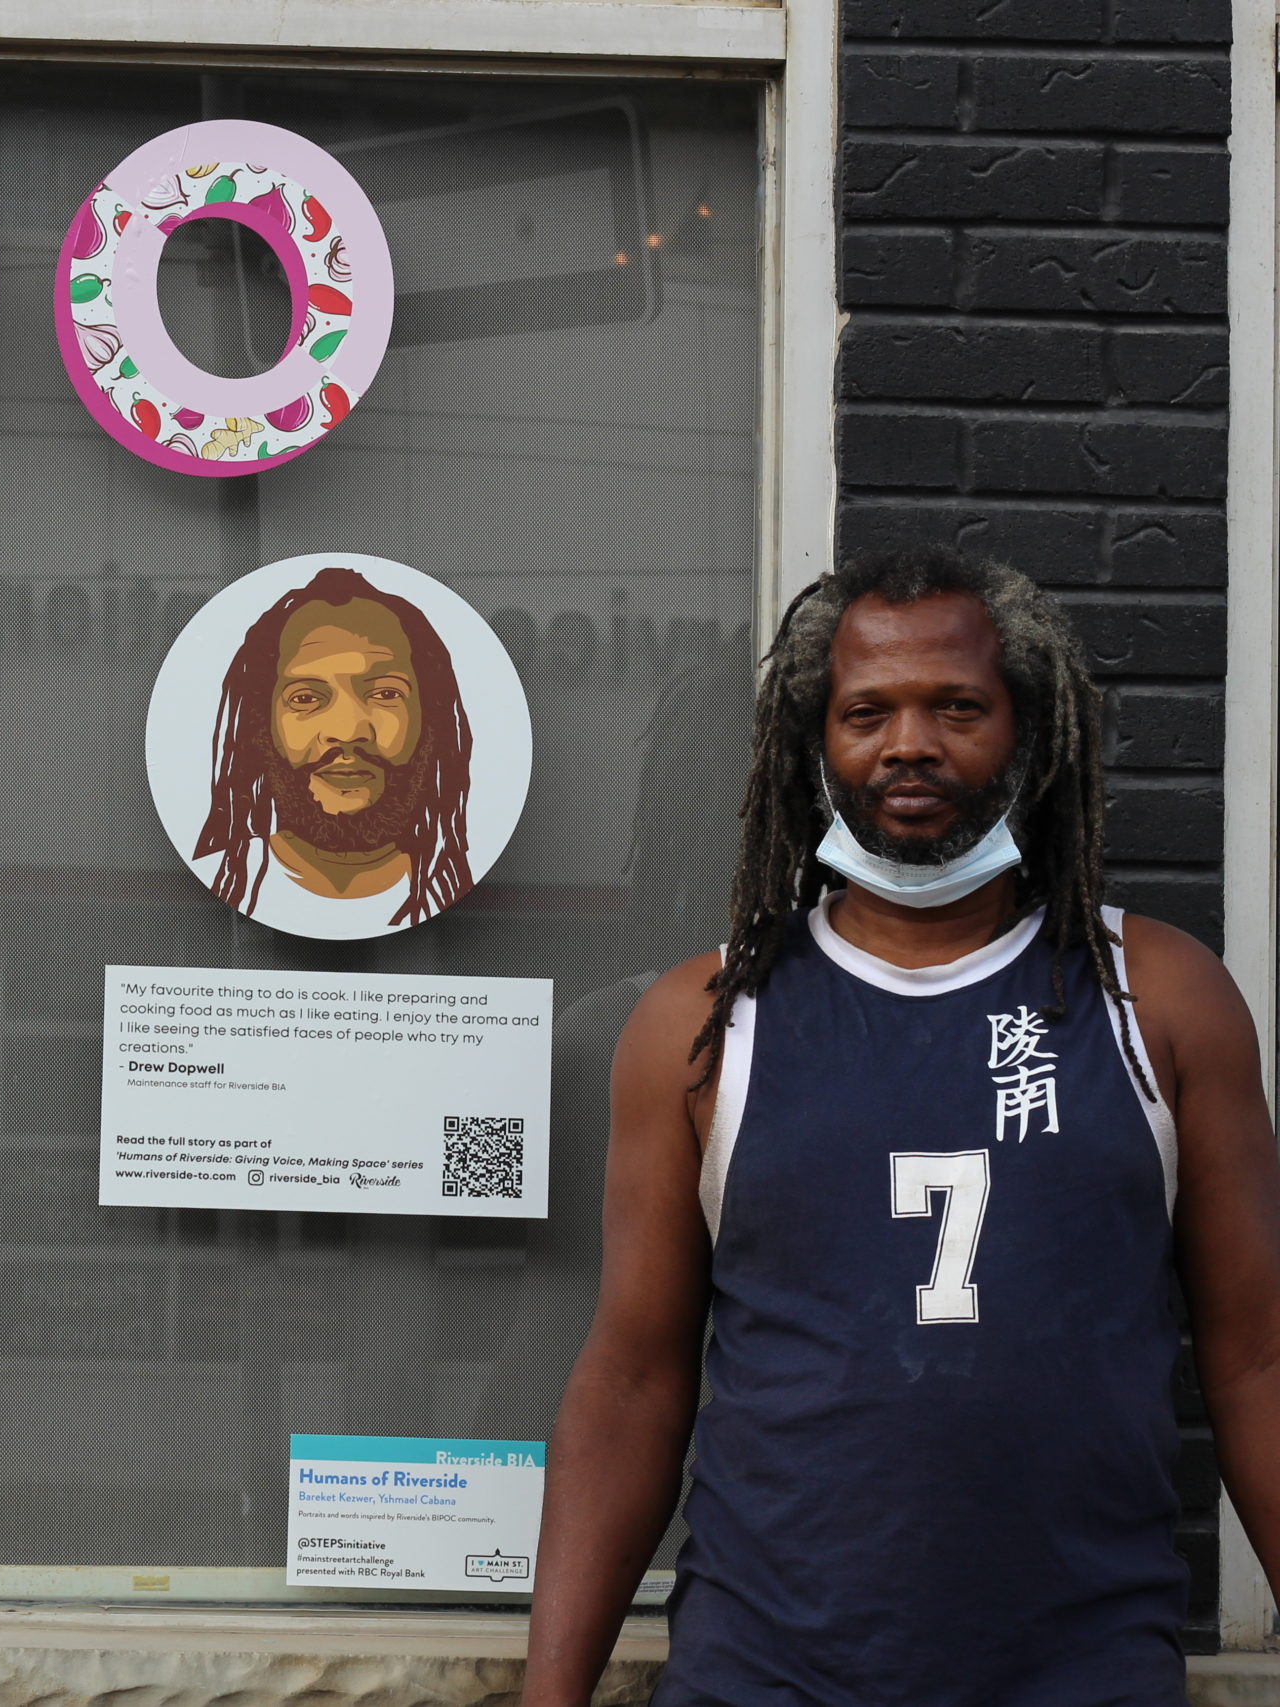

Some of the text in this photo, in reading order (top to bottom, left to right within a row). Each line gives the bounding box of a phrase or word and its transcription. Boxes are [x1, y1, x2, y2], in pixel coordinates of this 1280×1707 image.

[120, 983, 147, 998] "My
[150, 983, 214, 997] favourite
[217, 985, 254, 1001] thing
[257, 988, 272, 999] to
[275, 987, 294, 1000] do
[297, 988, 309, 1000] is
[311, 989, 349, 1001] cook.
[360, 990, 384, 1003] like
[386, 992, 456, 1008] preparing
[459, 993, 488, 1006] and
[119, 1002, 176, 1018] cooking
[179, 1003, 213, 1017] food
[215, 1007, 233, 1017] as
[236, 1006, 275, 1018] much
[278, 1009, 296, 1019] as
[306, 1007, 330, 1020] like
[333, 1009, 382, 1024] eating.
[393, 1010, 432, 1026] enjoy
[435, 1011, 459, 1024] the
[461, 1014, 508, 1026] aroma
[511, 1014, 540, 1027] and
[126, 1021, 151, 1034] like
[153, 1023, 200, 1038] seeing
[203, 1023, 227, 1036] the
[229, 1025, 290, 1038] satisfied
[293, 1025, 333, 1040] faces
[335, 1027, 352, 1040] of
[354, 1029, 404, 1044] people
[406, 1030, 437, 1043] who
[439, 1032, 459, 1046] try
[462, 1033, 484, 1047] my
[118, 1041, 194, 1054] creations."
[128, 1060, 165, 1073] Drew
[167, 1061, 225, 1076] Dopwell
[126, 1078, 287, 1091] Maintenance staff for Riverside BIA
[116, 1134, 272, 1150] Read the full story as part of
[116, 1151, 424, 1170] 'Humans of Riverside: Giving Voice, Making Space' series
[114, 1168, 401, 1188] www.riverside-to.com riverside_bia Riverside
[889, 1149, 991, 1325] 7
[436, 1451, 537, 1468] Riverside BIA
[299, 1467, 468, 1489] Humans of Riverside
[298, 1490, 457, 1506] Bareket Kezwer, Yshmael Cabana
[297, 1509, 496, 1525] Portraits and words inspired by Riverside's BIPOC community.
[297, 1537, 386, 1550] @STEPSinitiative
[296, 1553, 395, 1566] #mainstreetartchallenge
[486, 1560, 510, 1568] MAIN
[511, 1560, 524, 1568] ST.
[296, 1566, 426, 1580] presented with RBC Royal Bank
[484, 1567, 523, 1575] CHALLENGE
